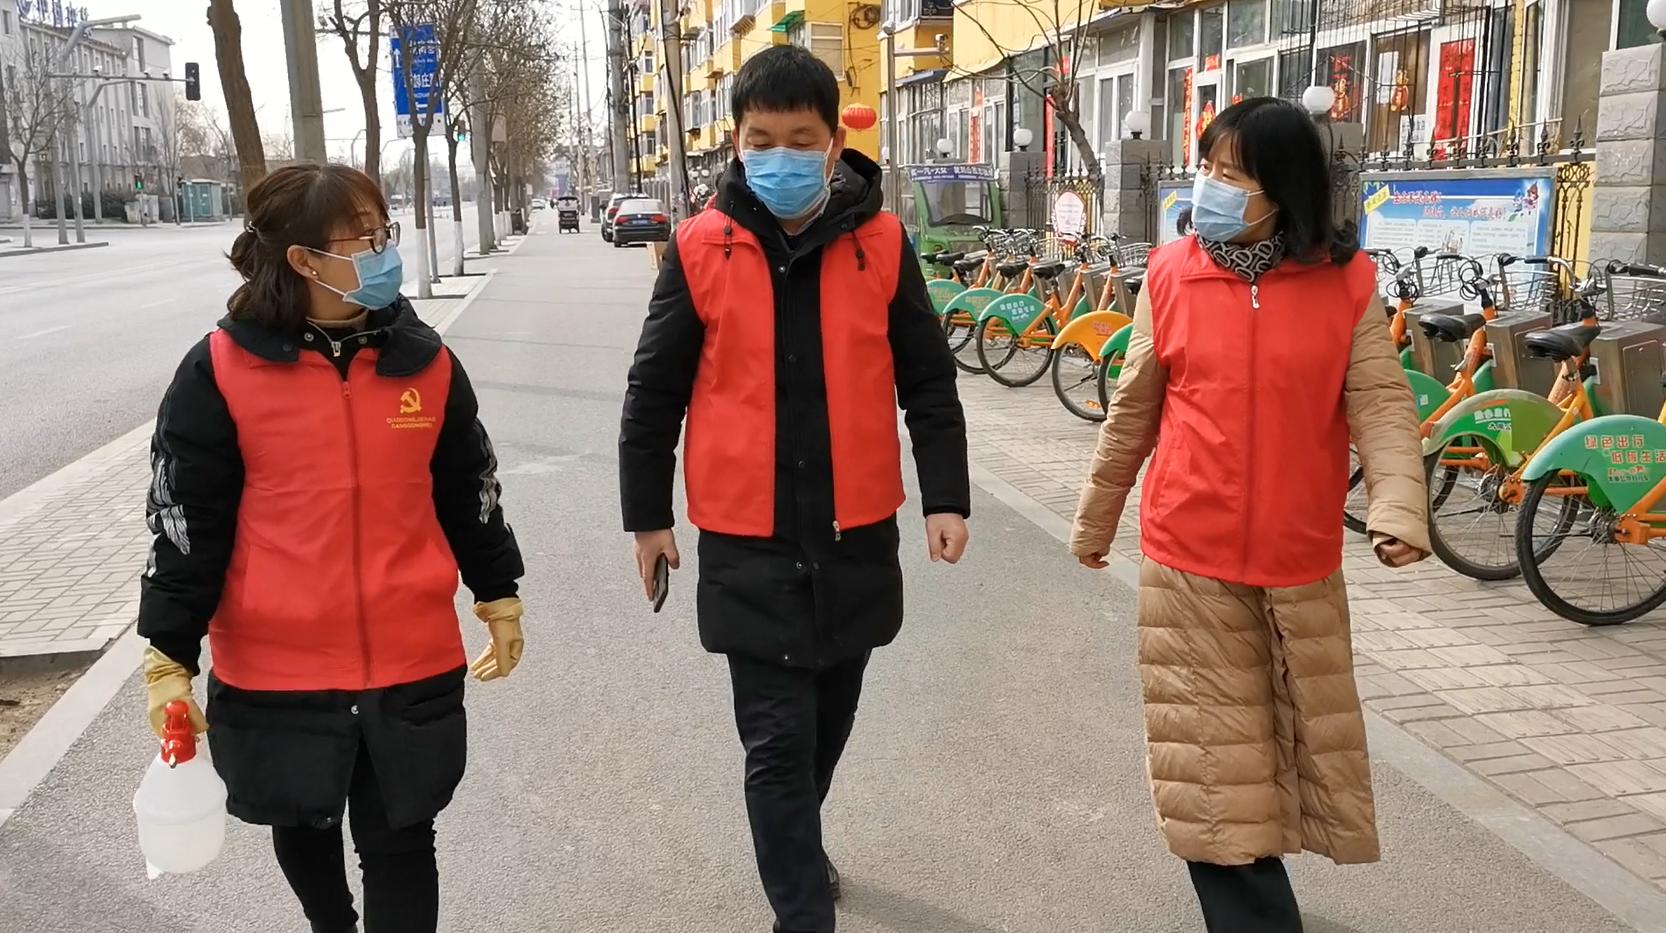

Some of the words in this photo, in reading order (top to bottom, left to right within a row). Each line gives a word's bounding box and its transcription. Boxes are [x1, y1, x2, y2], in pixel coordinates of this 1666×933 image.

[1585, 434, 1645, 449] 绿色出行
[1611, 449, 1666, 464] 低碳生活
